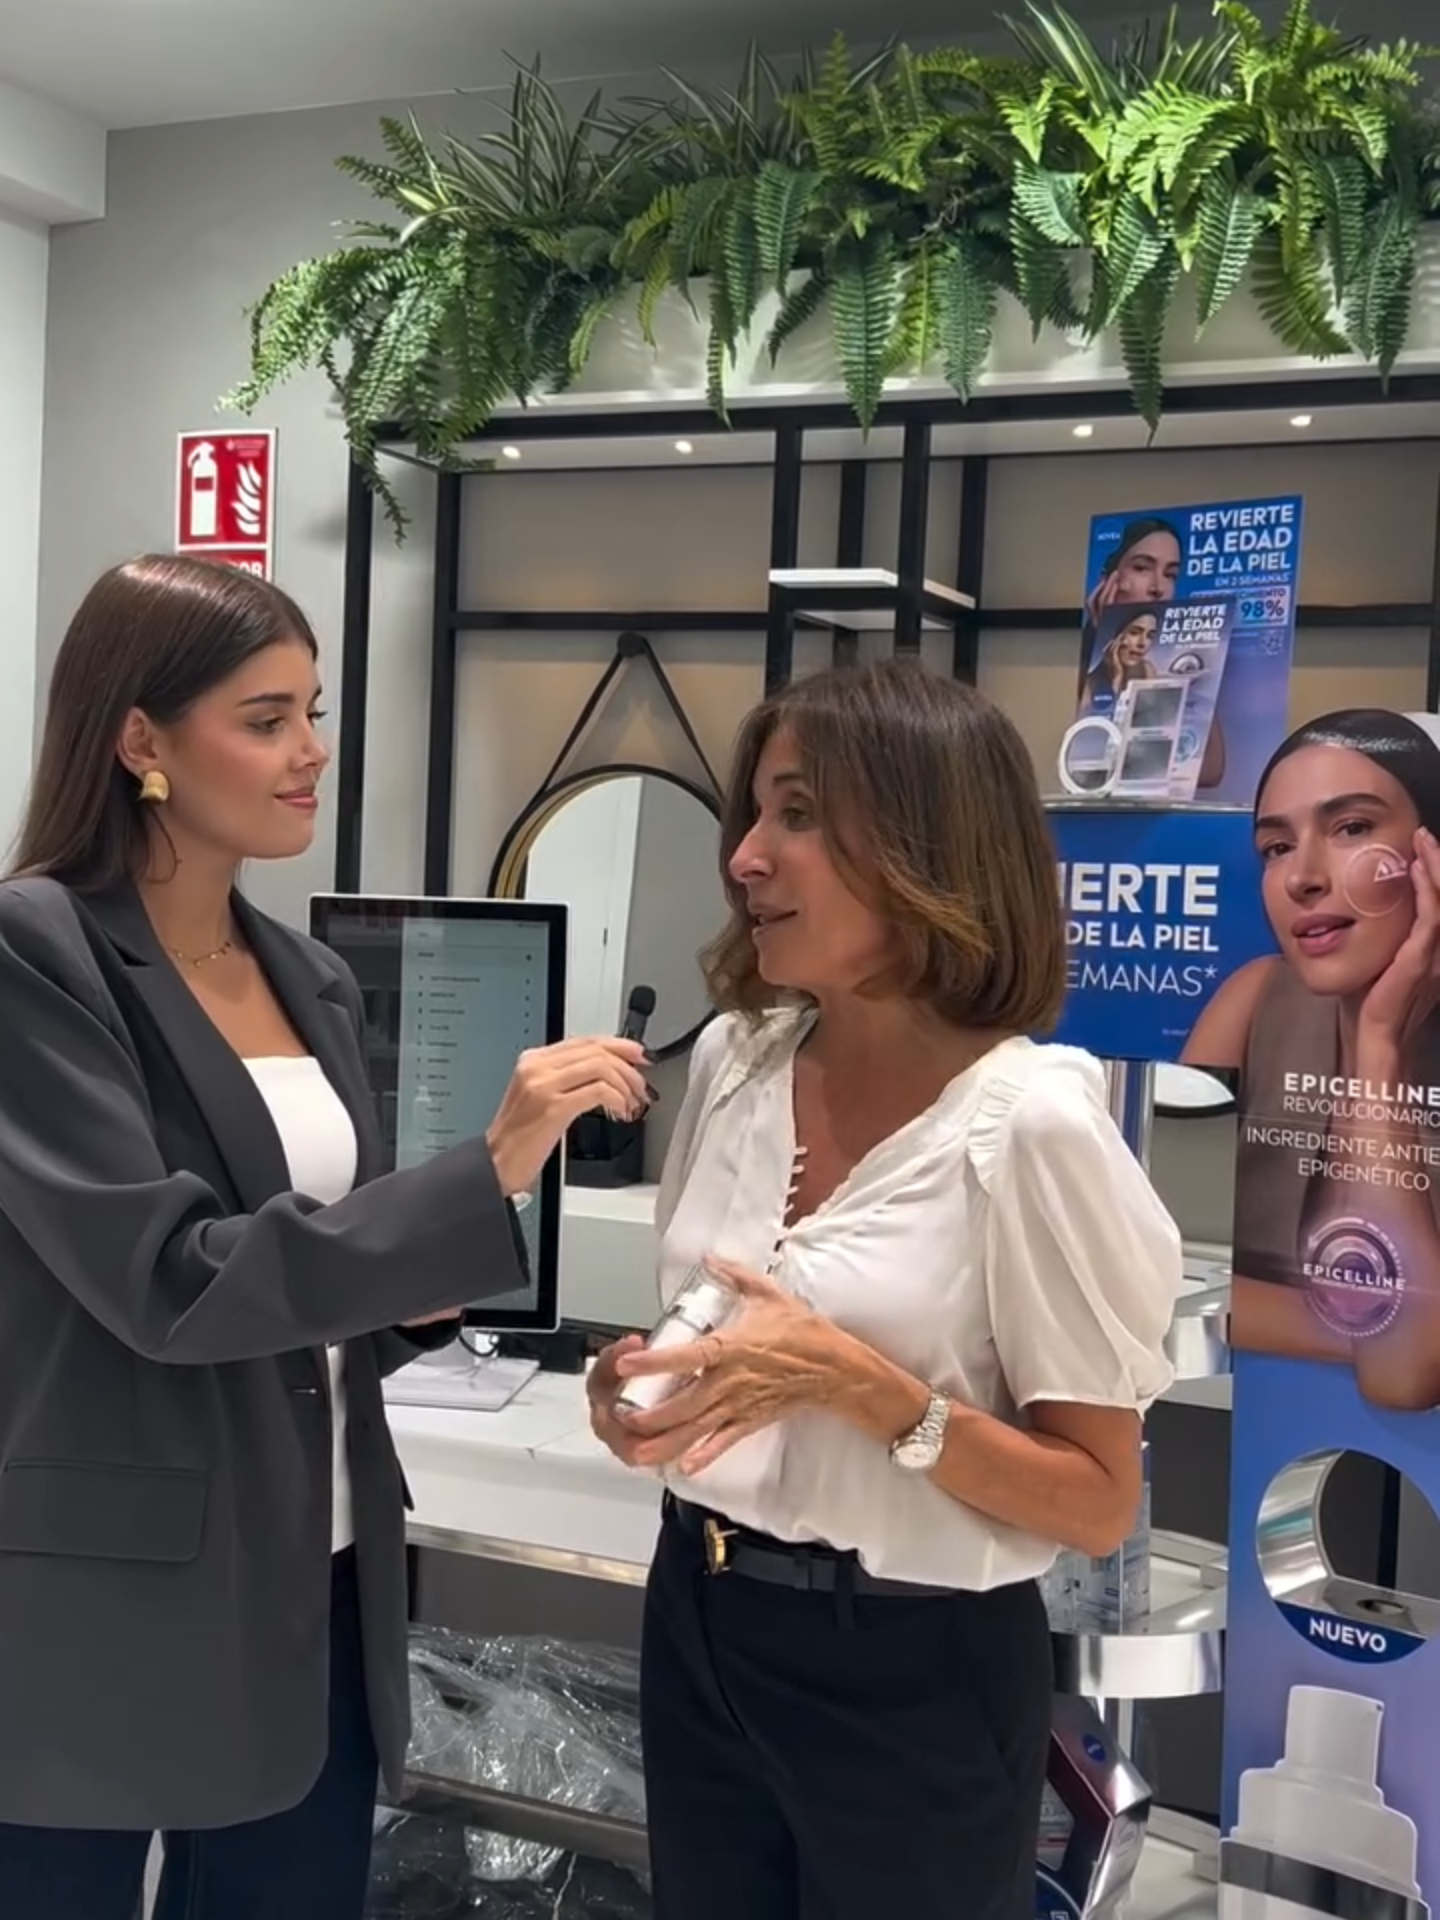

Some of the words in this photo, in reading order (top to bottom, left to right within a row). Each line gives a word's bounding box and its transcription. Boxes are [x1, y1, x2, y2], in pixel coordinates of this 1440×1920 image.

[1190, 504, 1294, 532] REVIERTE
[1189, 534, 1218, 555] LA
[1223, 527, 1293, 553] EDAD
[1187, 557, 1214, 576] DE
[1218, 556, 1243, 573] LA
[1247, 552, 1291, 571] PIEL
[1165, 604, 1226, 619] REVIERTE
[1241, 599, 1285, 619] 98%
[1159, 633, 1176, 645] DE
[1177, 632, 1192, 643] LA
[1195, 631, 1220, 642] PIEL
[1162, 619, 1179, 632] LA
[1182, 617, 1224, 631] EDAD
[1065, 921, 1102, 946] DE
[1110, 922, 1146, 949] LA
[1154, 924, 1219, 952] PIEL
[1284, 1072, 1440, 1107] EPICELLINE
[1247, 1126, 1377, 1157] INGREDIENTE
[1298, 1157, 1430, 1191] EPIGENÉTICO
[1303, 1263, 1405, 1291] EPICELLINE
[1309, 1616, 1387, 1653] NUEVO
